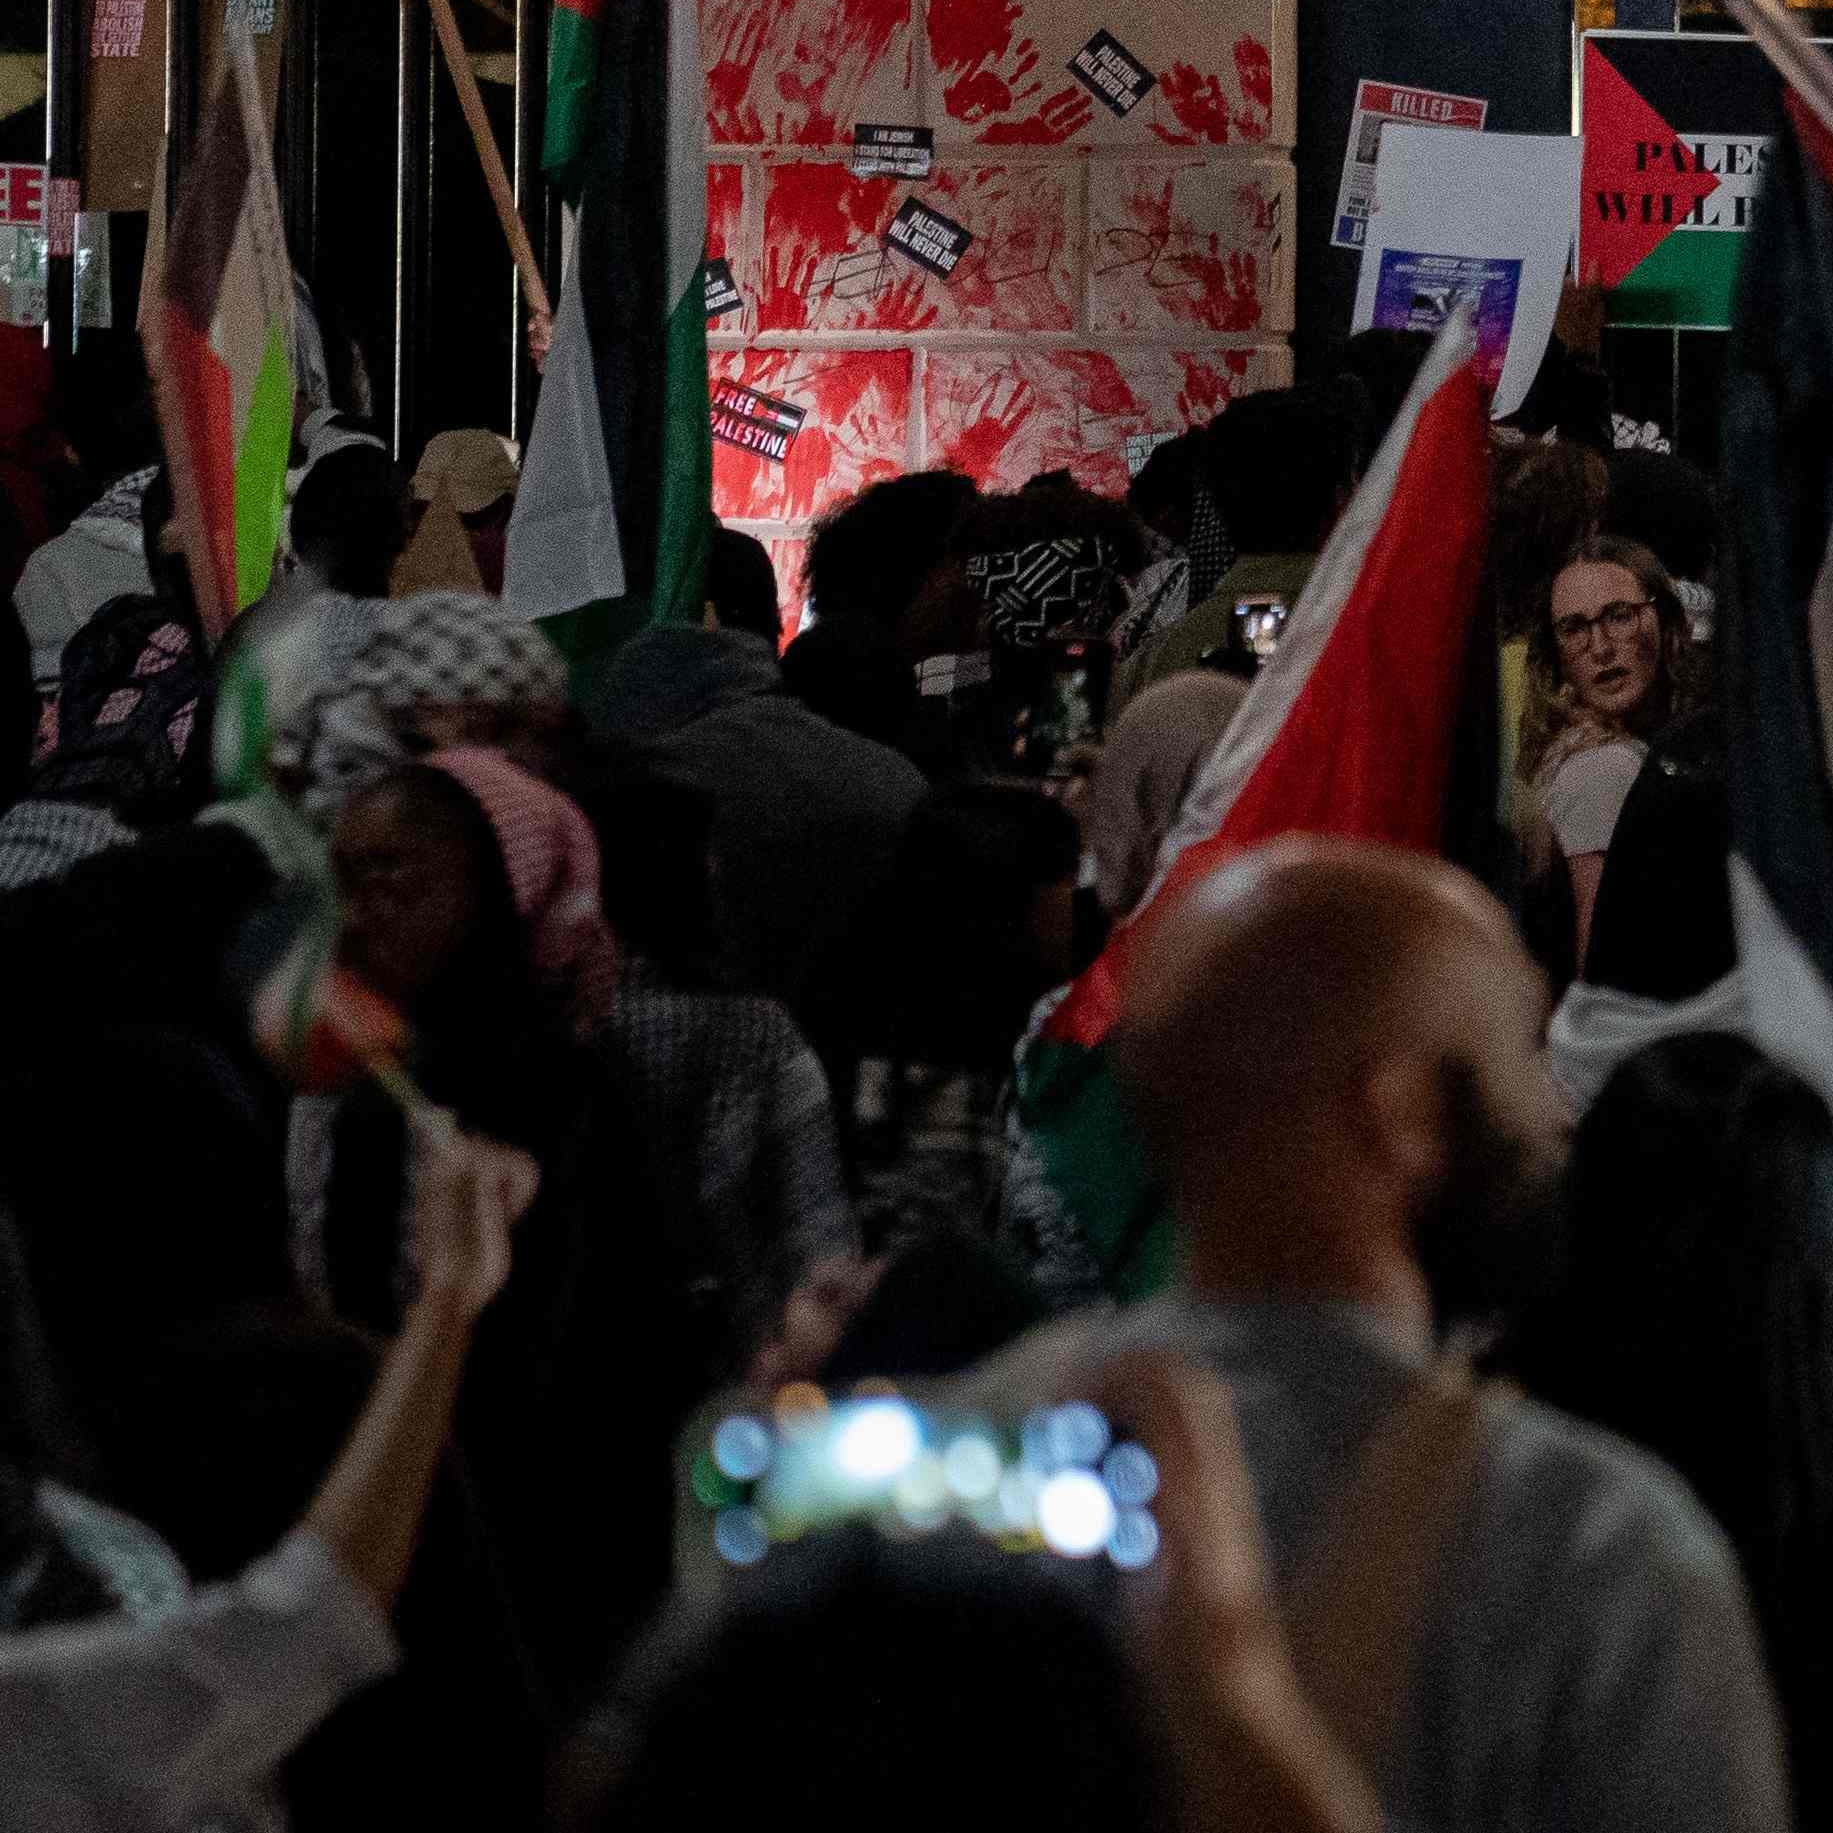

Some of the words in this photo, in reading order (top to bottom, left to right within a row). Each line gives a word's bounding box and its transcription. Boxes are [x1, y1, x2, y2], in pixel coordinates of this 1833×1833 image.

[90, 42, 140, 58] STATE
[1095, 44, 1142, 89] PALESTINE
[1091, 66, 1124, 99] NEVER
[1391, 92, 1454, 121] KILLED
[1595, 192, 1720, 226] WILL
[888, 219, 911, 246] WILL
[909, 231, 943, 263] NEVER
[907, 210, 959, 249] PALESTINE
[713, 385, 757, 417] FREE
